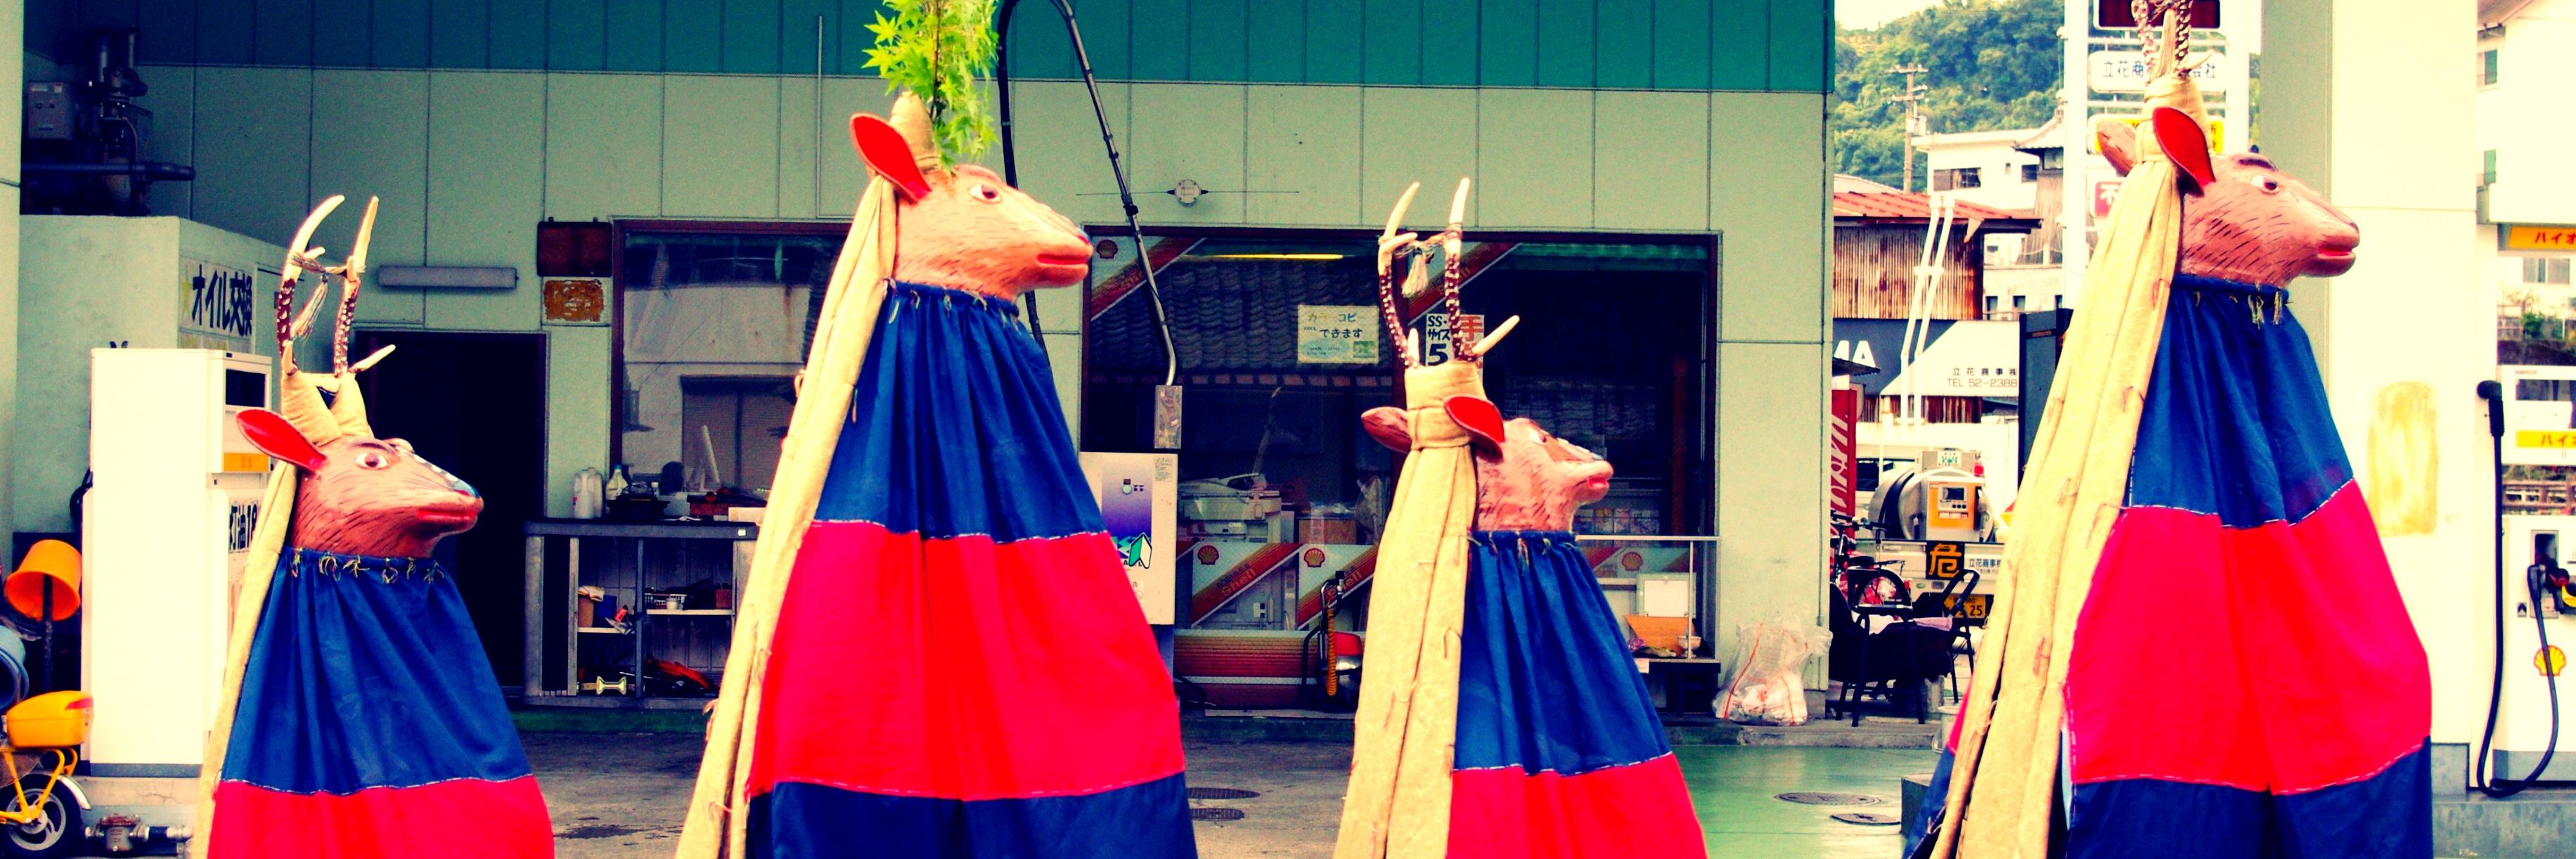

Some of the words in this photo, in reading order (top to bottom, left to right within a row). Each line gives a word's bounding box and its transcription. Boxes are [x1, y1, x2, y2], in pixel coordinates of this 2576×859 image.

[2104, 60, 2216, 79] 立花商会社
[191, 264, 252, 337] オイル交換
[1320, 328, 1363, 338] できます
[1947, 378, 1964, 387] TEL
[1969, 378, 2017, 388] 52-2388
[1928, 543, 1962, 578] 危
[1327, 571, 1363, 599] Sell
